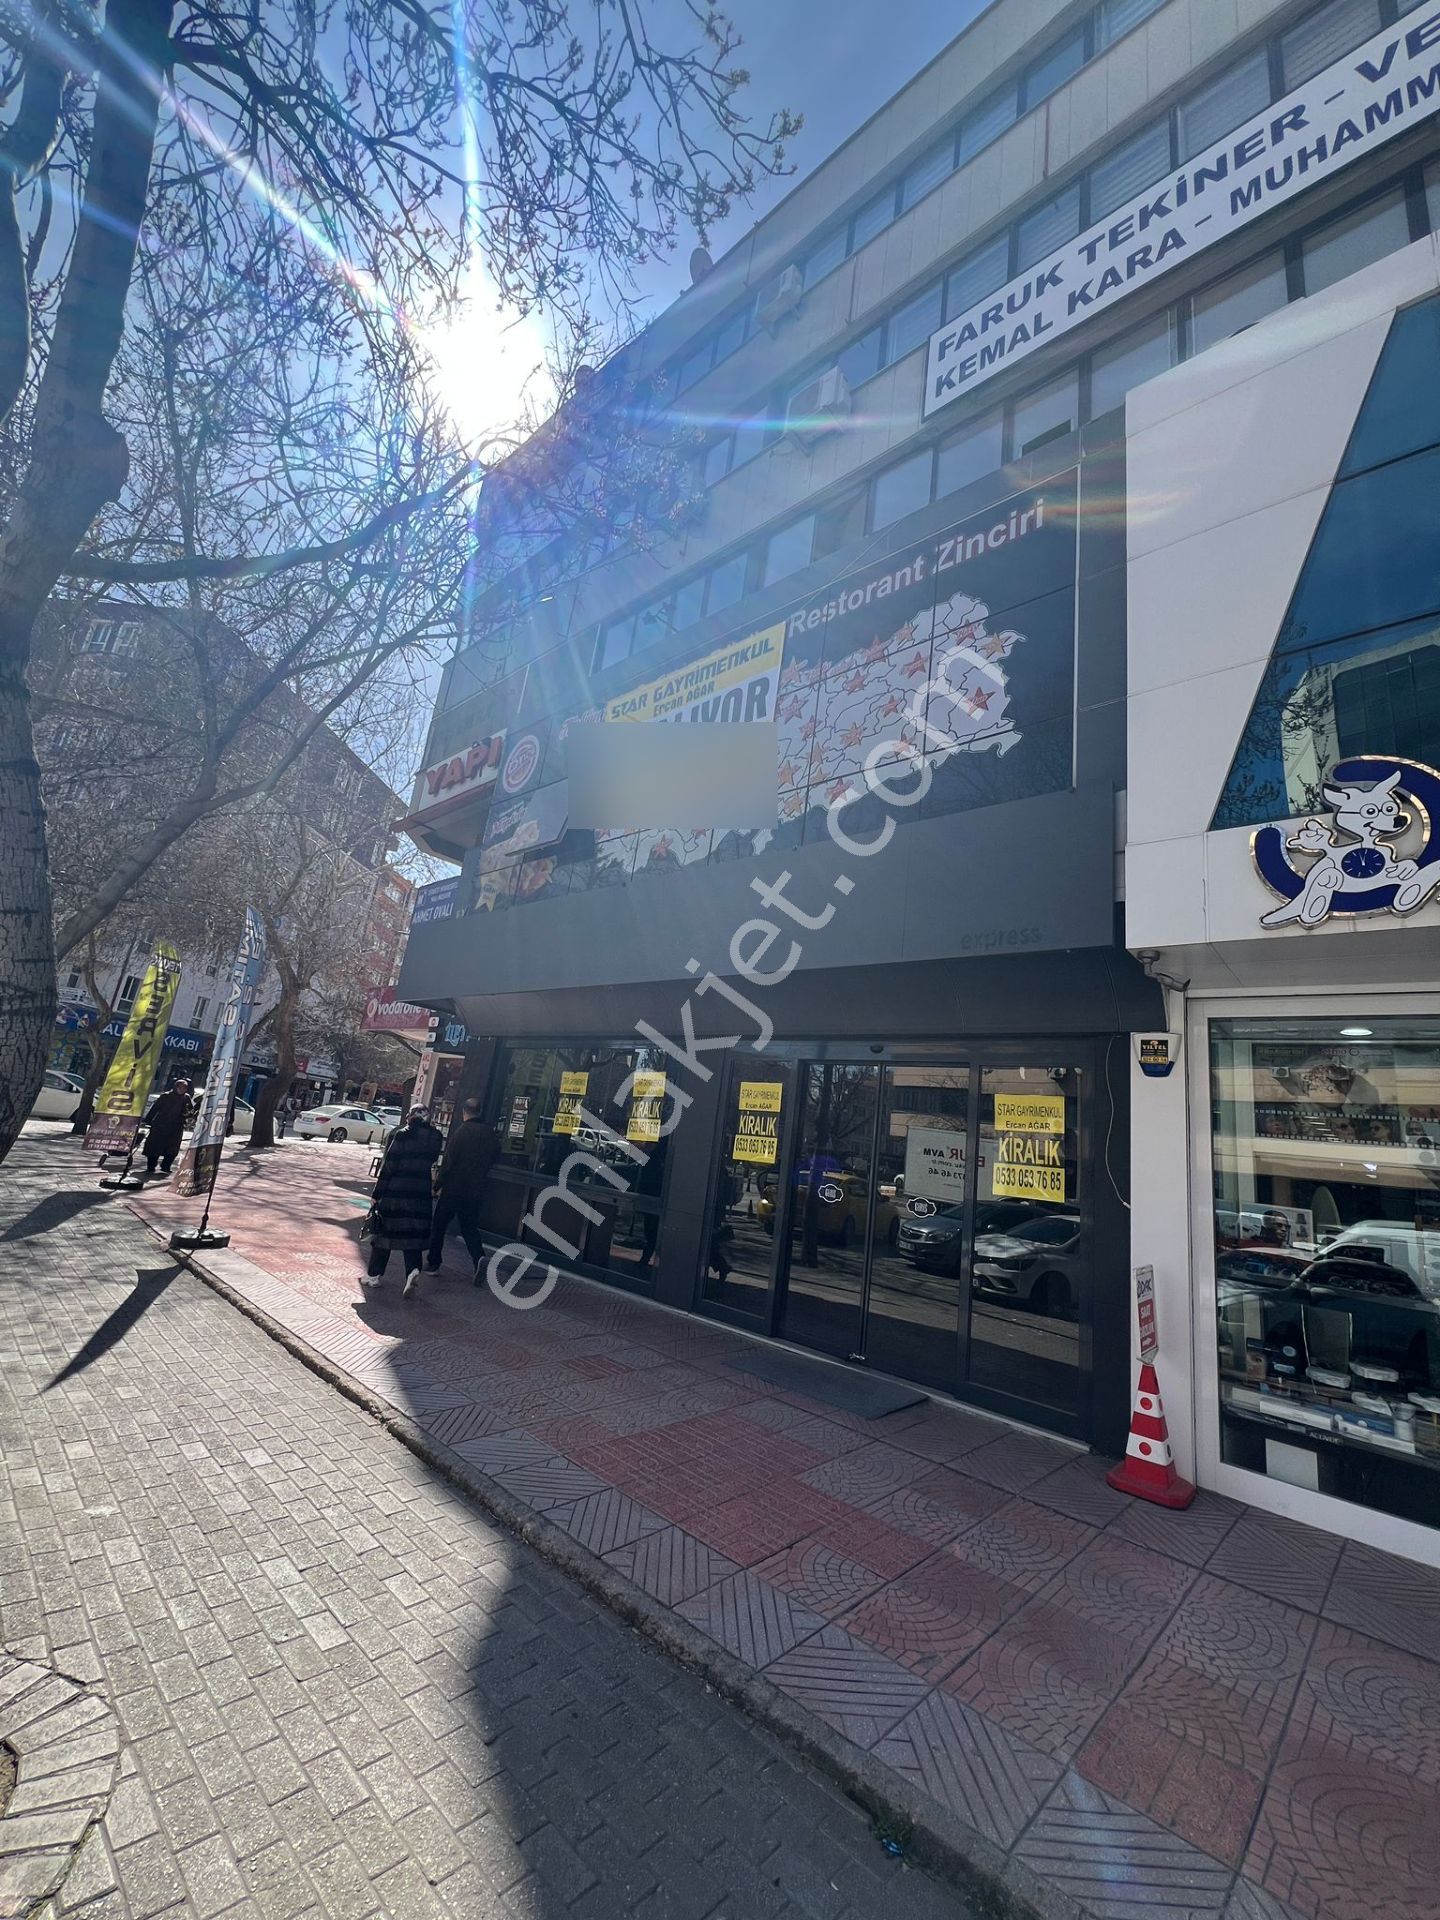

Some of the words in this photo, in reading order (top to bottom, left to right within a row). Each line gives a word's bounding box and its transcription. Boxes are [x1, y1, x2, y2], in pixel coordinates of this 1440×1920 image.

[938, 260, 1064, 362] FARUK
[1078, 104, 1310, 266] TEKİNER
[935, 312, 1053, 398] KEMAL
[1067, 233, 1187, 316] KARA
[788, 555, 925, 638] Restorant
[931, 498, 1044, 574] Zinciri
[611, 692, 648, 720] STAR
[653, 694, 683, 717] Ercan
[997, 1104, 1016, 1115] STAR
[739, 1111, 777, 1137] KİRALIK
[1005, 1121, 1026, 1129] Ercan
[998, 1132, 1061, 1166] KİRALIK
[995, 1166, 1016, 1186] 0533
[1018, 1168, 1035, 1188] 053
[1037, 1170, 1048, 1189] 76
[1050, 1171, 1062, 1191] 85
